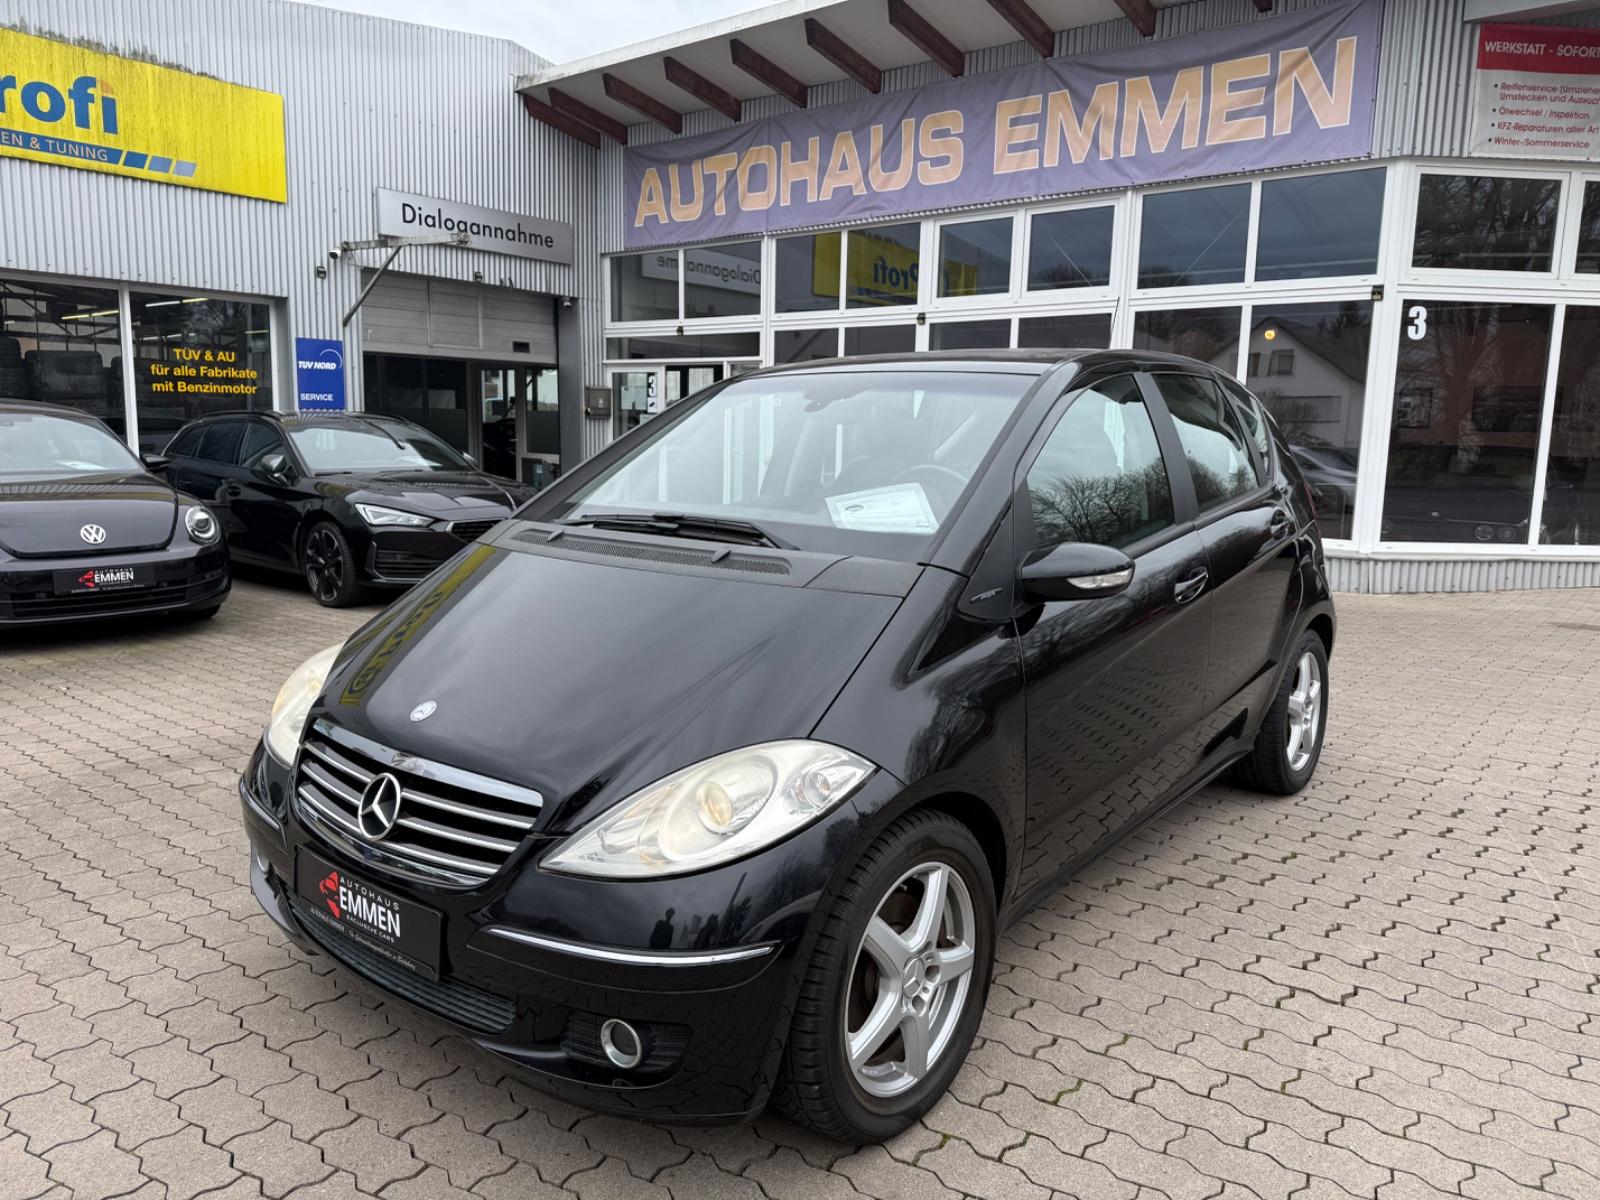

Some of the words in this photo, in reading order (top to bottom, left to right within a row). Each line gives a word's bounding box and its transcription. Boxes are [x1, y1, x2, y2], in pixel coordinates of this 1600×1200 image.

[1485, 41, 1546, 55] WERKSTATT
[1500, 82, 1558, 93] Reifenservice
[1499, 92, 1548, 102] Umstecken
[1550, 94, 1567, 104] und
[1498, 106, 1543, 117] Ölwechsel
[1549, 109, 1590, 121] Inspektion
[633, 110, 965, 228] AUTOHAUS
[993, 36, 1358, 175] EMMEN
[1497, 121, 1564, 134] KFZ-Reparaturen
[1565, 126, 1586, 134] aller
[1587, 126, 1600, 135] Art
[29, 136, 41, 151] &
[45, 139, 109, 162] TUNING
[401, 203, 555, 249] Dialogannahme
[1407, 305, 1428, 341] 3
[173, 346, 201, 363] TÜV
[204, 349, 215, 363] &
[216, 350, 236, 363] AU
[150, 364, 169, 376] für
[173, 366, 197, 378] alle
[200, 365, 258, 380] Fabrikate
[313, 361, 337, 371] NORD
[152, 380, 174, 393] mit
[177, 381, 258, 395] Benzinmotor
[300, 392, 334, 402] SERVICE
[94, 571, 134, 584] EMMEN
[340, 876, 400, 911] AUTOHAUS
[339, 885, 401, 938] EMMEN
